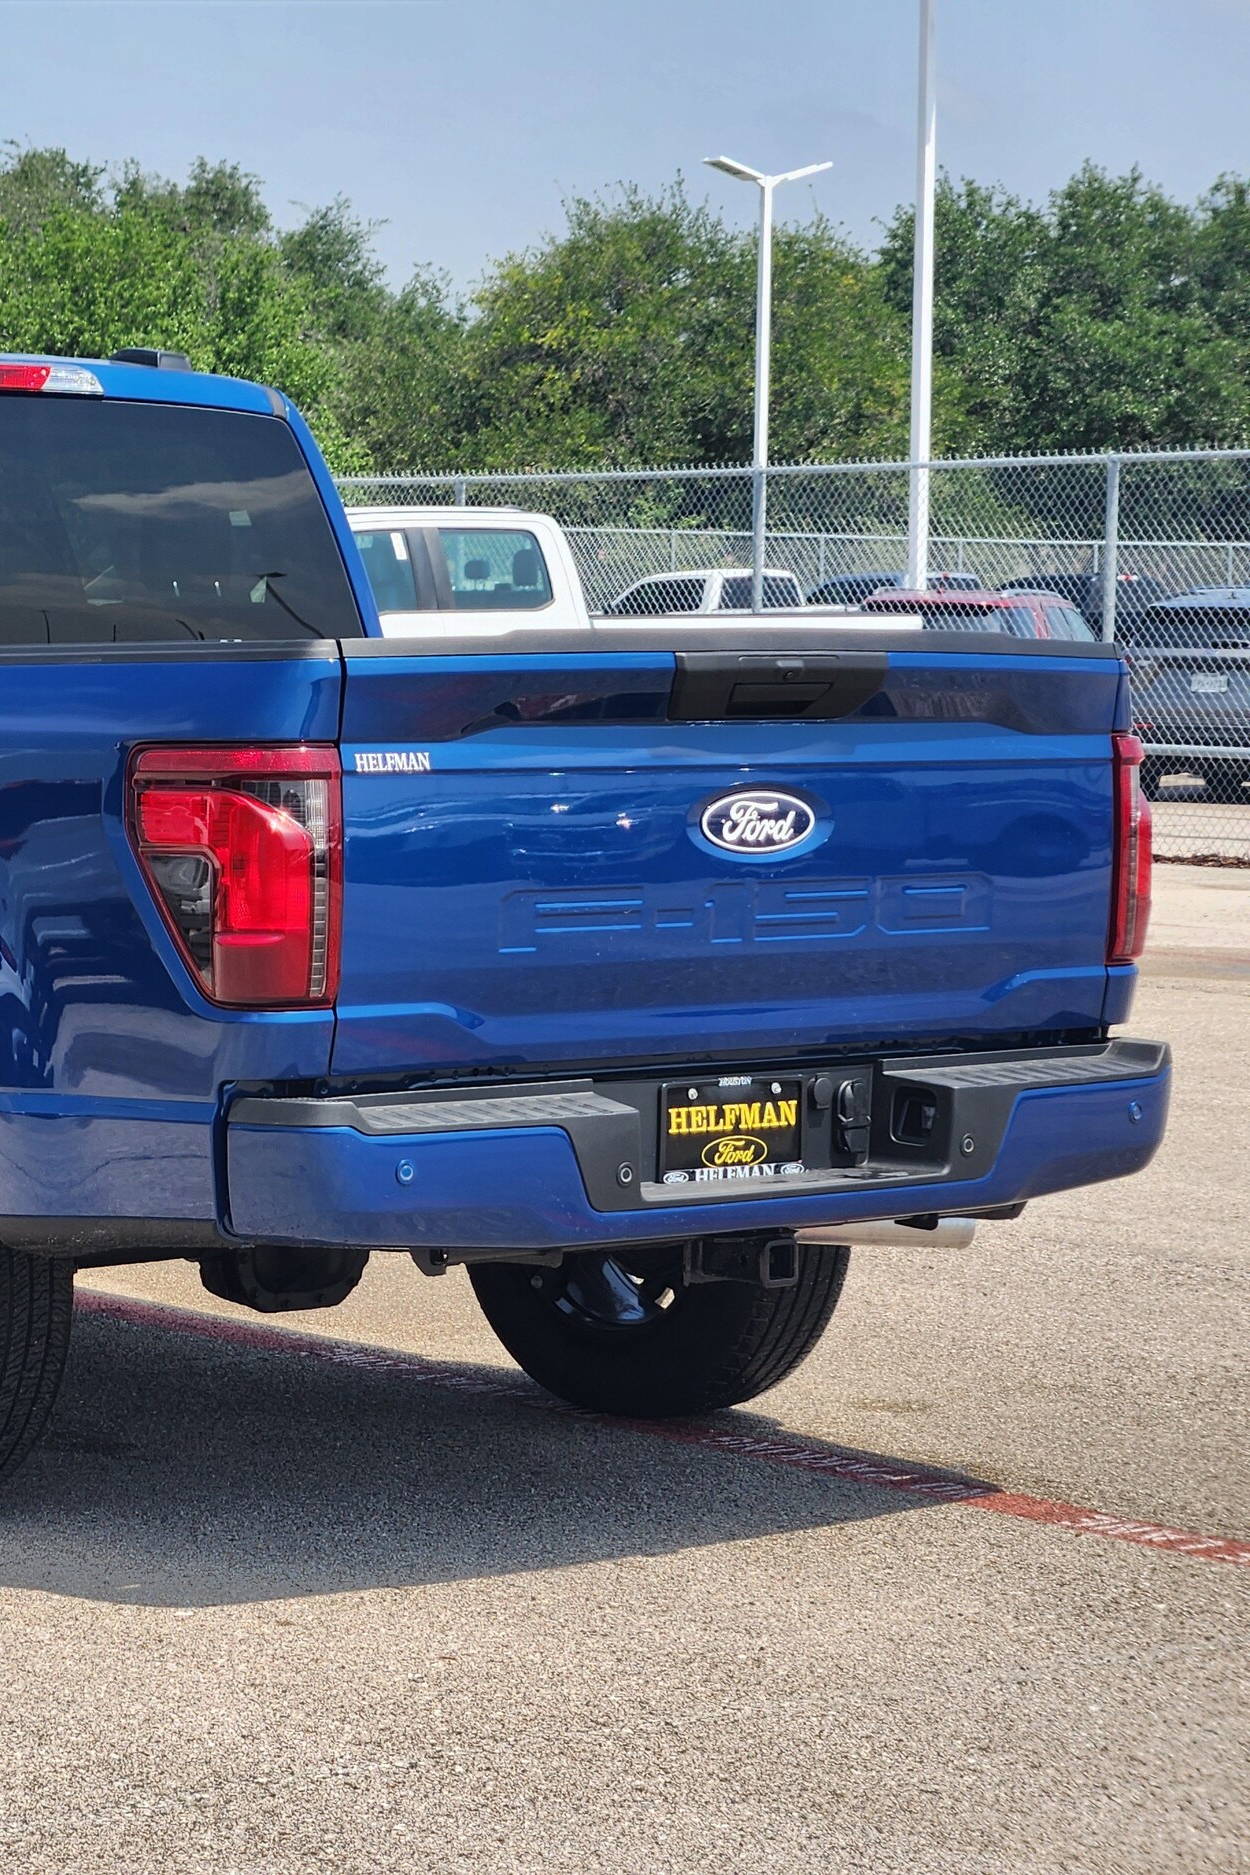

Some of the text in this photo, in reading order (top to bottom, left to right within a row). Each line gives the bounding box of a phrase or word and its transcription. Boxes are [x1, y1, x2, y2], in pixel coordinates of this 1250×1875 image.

[354, 752, 431, 772] HELFMAN
[722, 800, 796, 841] Ford
[498, 871, 994, 954] F-150
[668, 1100, 797, 1135] HELFMAN
[714, 1138, 756, 1165] Ford
